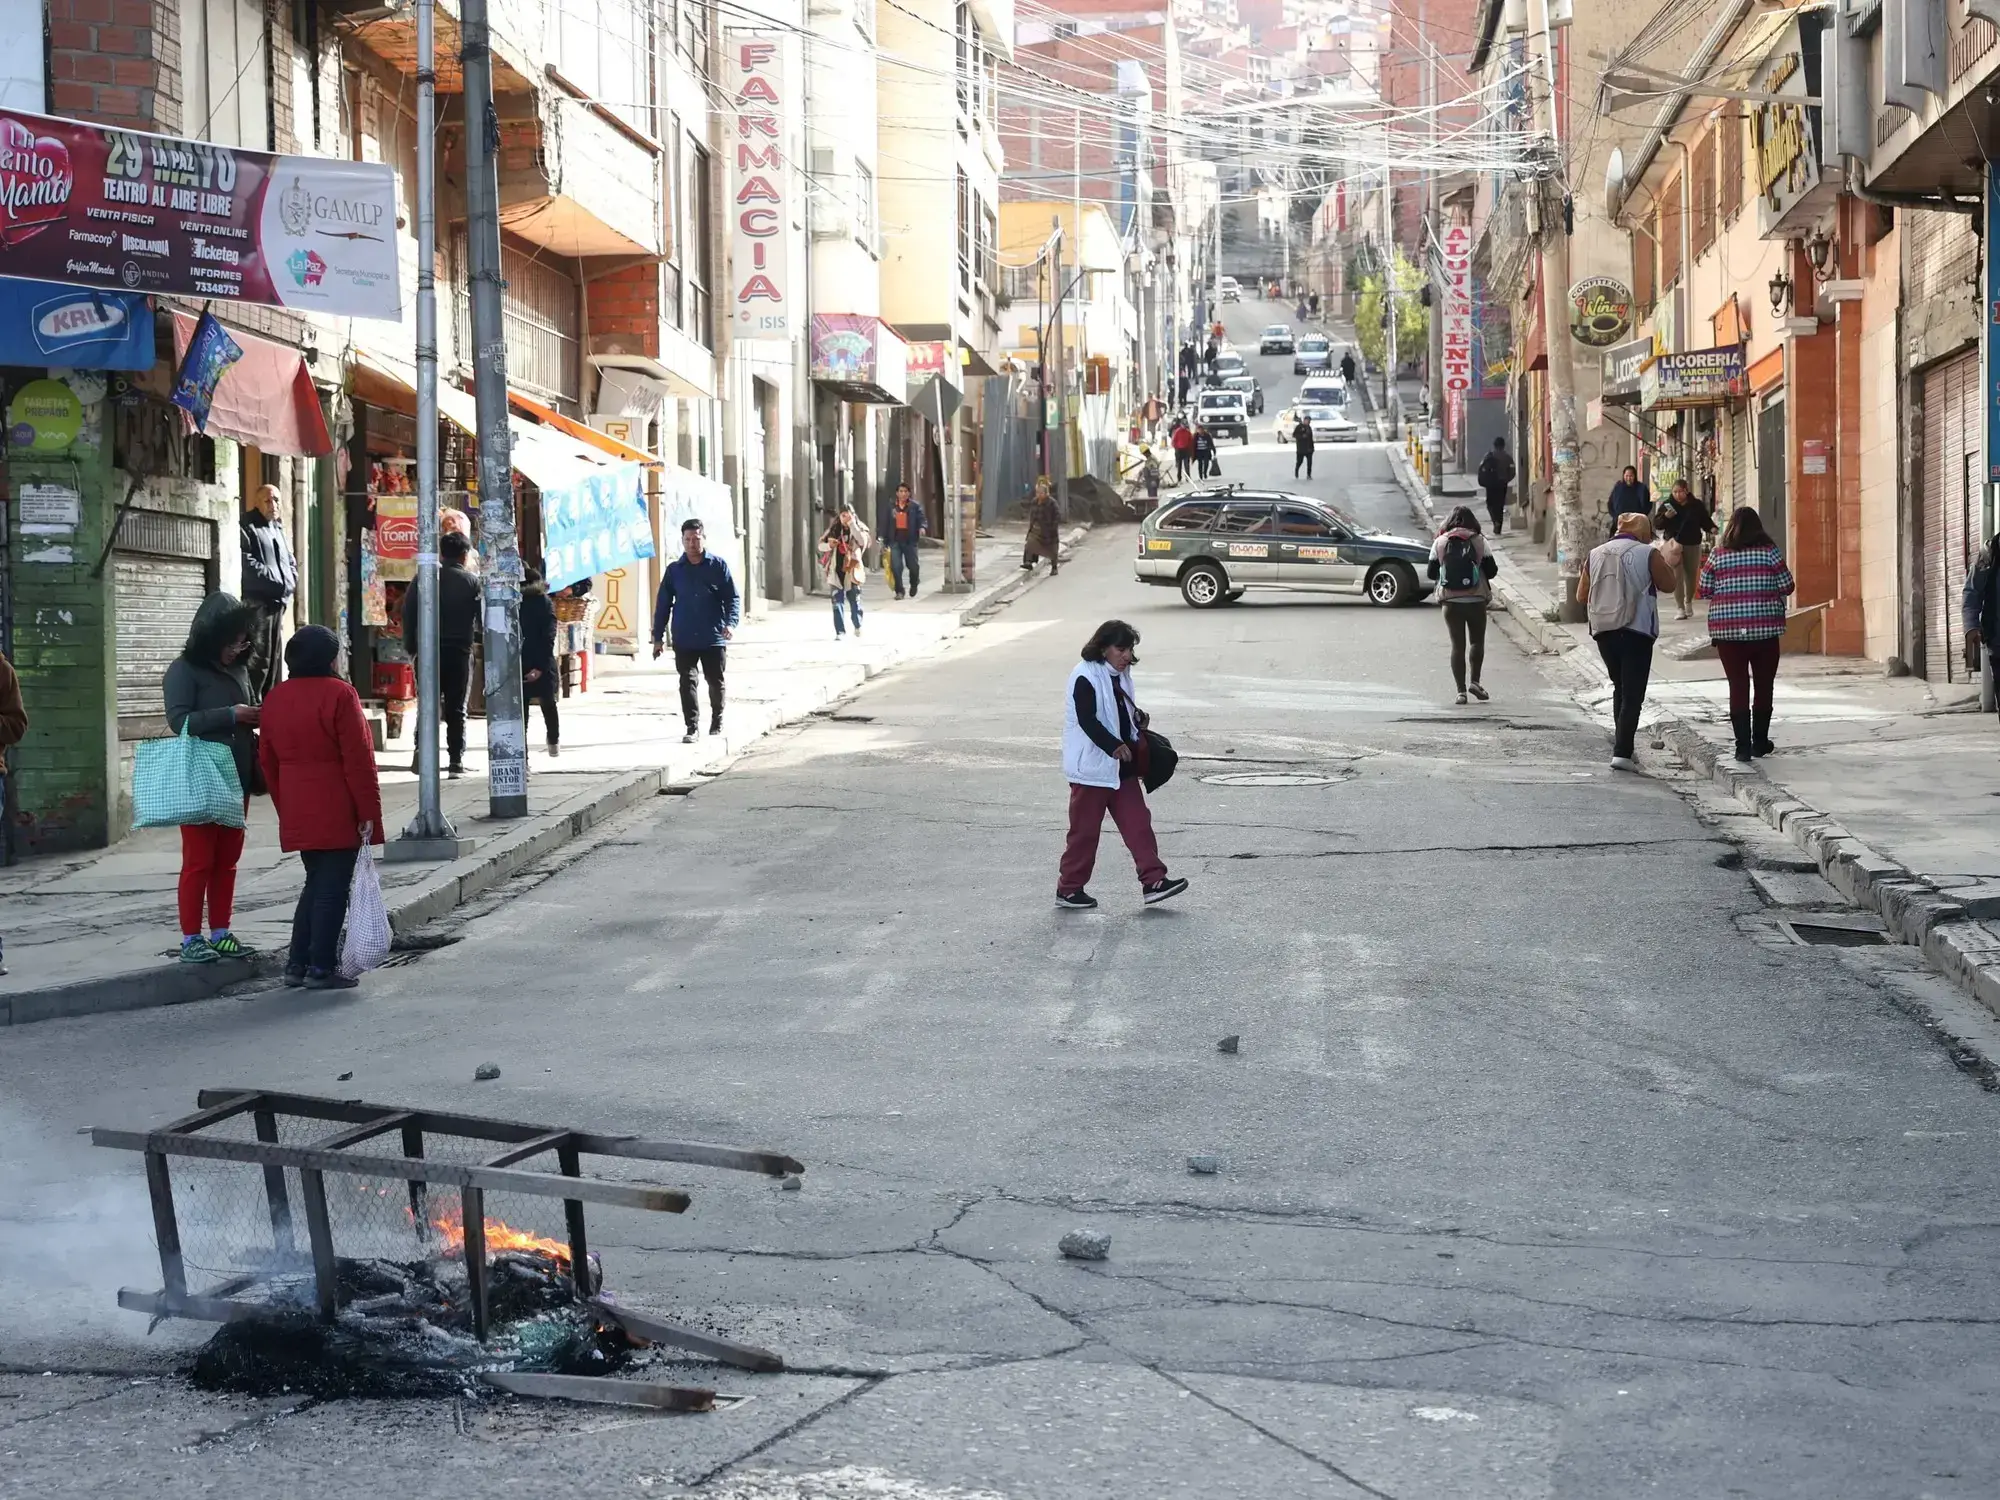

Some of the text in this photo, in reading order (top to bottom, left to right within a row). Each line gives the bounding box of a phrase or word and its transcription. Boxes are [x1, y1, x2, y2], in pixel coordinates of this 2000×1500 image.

[104, 130, 143, 178] 29
[151, 147, 195, 172] LA PAZ
[736, 44, 783, 303] FARMACIA
[103, 178, 232, 217] TEATRO AL AIRE LIBRE
[87, 207, 121, 221] VENTA
[314, 196, 383, 226] GAMLP
[69, 229, 113, 248] Farmacorp
[180, 221, 248, 239] VENTA ONLINE
[122, 233, 170, 257] DISCOLANDIA
[141, 269, 170, 280] ANDINA
[190, 267, 242, 281] INFORMES
[305, 258, 321, 272] Paz
[1571, 279, 1626, 299] CONFITERIA
[1444, 228, 1469, 390] ALOJAMIENTO
[1575, 294, 1629, 319] Wiñay
[52, 308, 101, 334] KRI
[1662, 352, 1741, 368] LICORERIA
